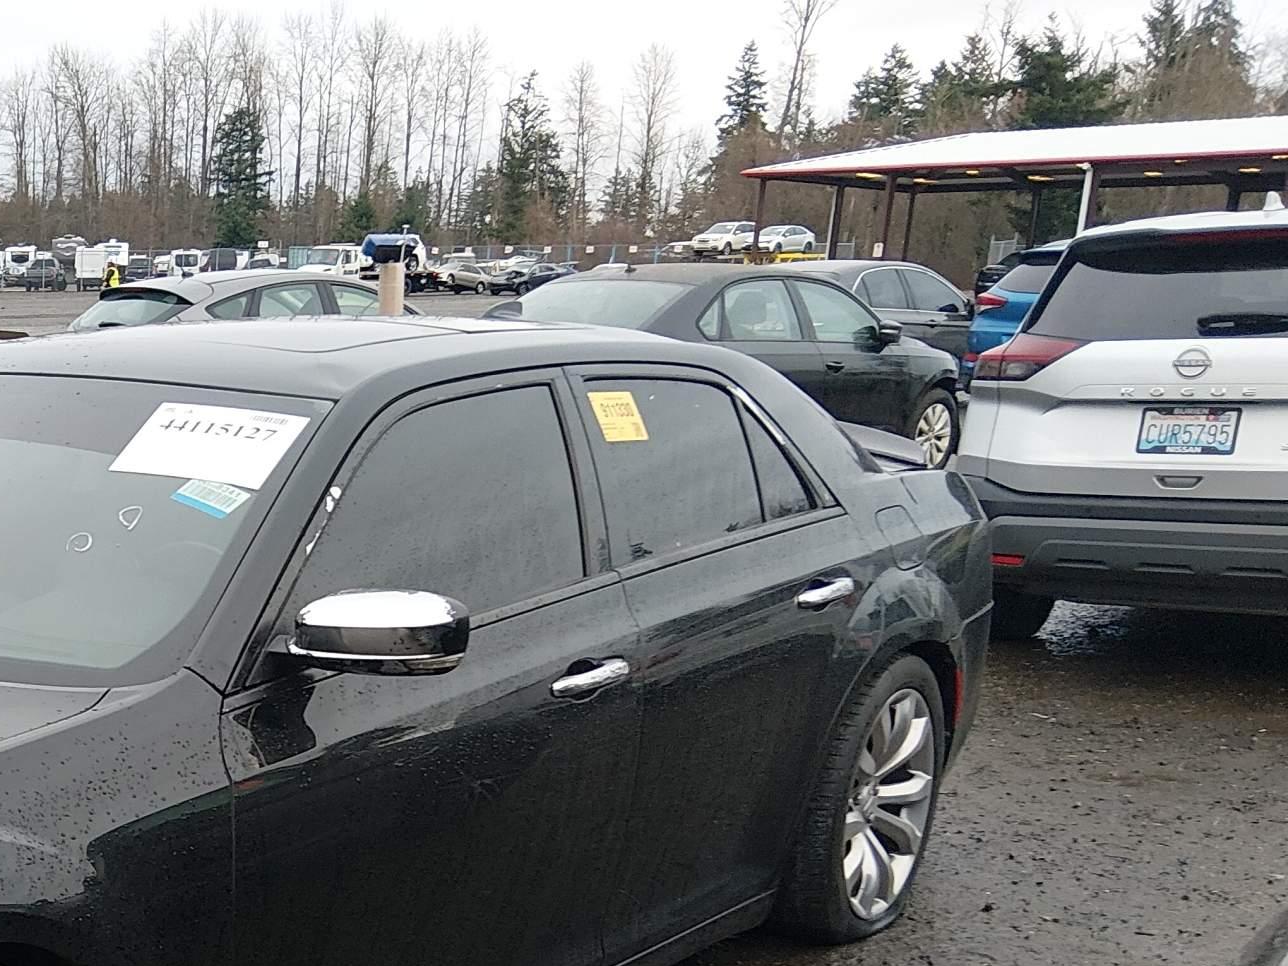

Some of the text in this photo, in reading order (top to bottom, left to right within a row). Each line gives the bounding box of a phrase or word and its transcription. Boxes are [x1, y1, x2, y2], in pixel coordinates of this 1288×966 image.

[1121, 387, 1256, 397] ROGUE
[159, 418, 278, 441] 44115127
[1145, 423, 1231, 444] CUR5795
